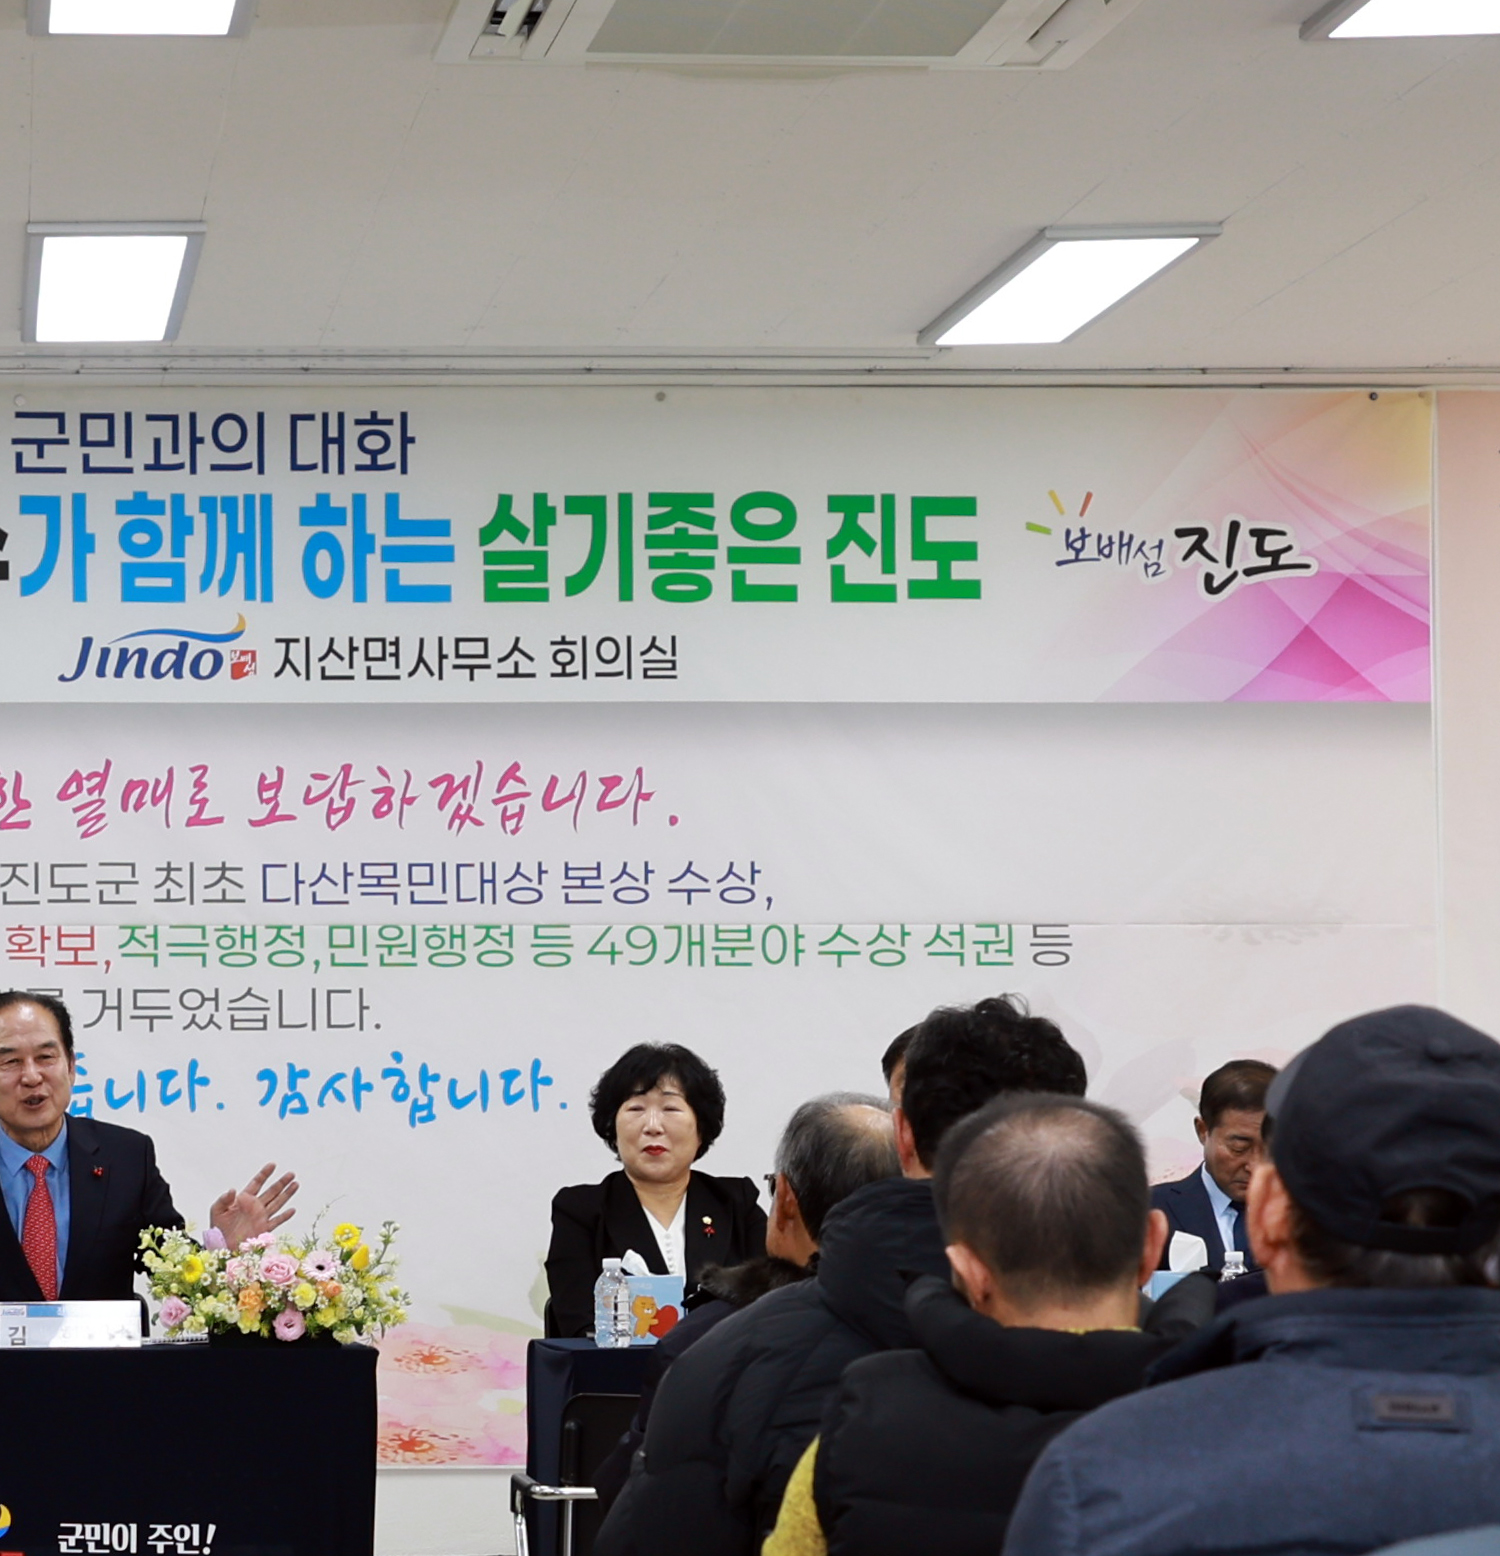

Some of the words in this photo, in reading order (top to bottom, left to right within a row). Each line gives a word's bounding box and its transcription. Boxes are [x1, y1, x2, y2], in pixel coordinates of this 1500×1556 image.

[10, 410, 268, 477] 군민과의
[289, 409, 417, 477] 대화
[115, 491, 275, 605] 함께
[299, 492, 457, 605] 하는
[479, 490, 803, 605] 살기좋은
[827, 493, 983, 605] 진도
[1055, 526, 1165, 579] 보배섬
[1174, 520, 1312, 596] 진도
[58, 636, 224, 683] Jindo
[273, 635, 539, 685] 지산면사무소
[550, 634, 679, 682] 회의실
[57, 759, 226, 841] 열매로
[248, 760, 680, 837] 보답하겠습니다.
[0, 862, 141, 907] 진도군
[154, 861, 248, 907] 최초
[262, 861, 550, 907] 다산목민대상
[562, 861, 657, 906] 본상
[668, 861, 774, 912] 수상,
[531, 924, 575, 969] 등
[587, 924, 807, 969] 49개분야
[818, 924, 913, 969] 수상
[924, 923, 1015, 968] 석권
[1030, 924, 1074, 968] 등
[82, 987, 382, 1034] 거두었습니다.
[256, 1050, 568, 1129] 감사합니다.
[57, 1522, 138, 1554] 군민이
[146, 1522, 217, 1556] 주인!
